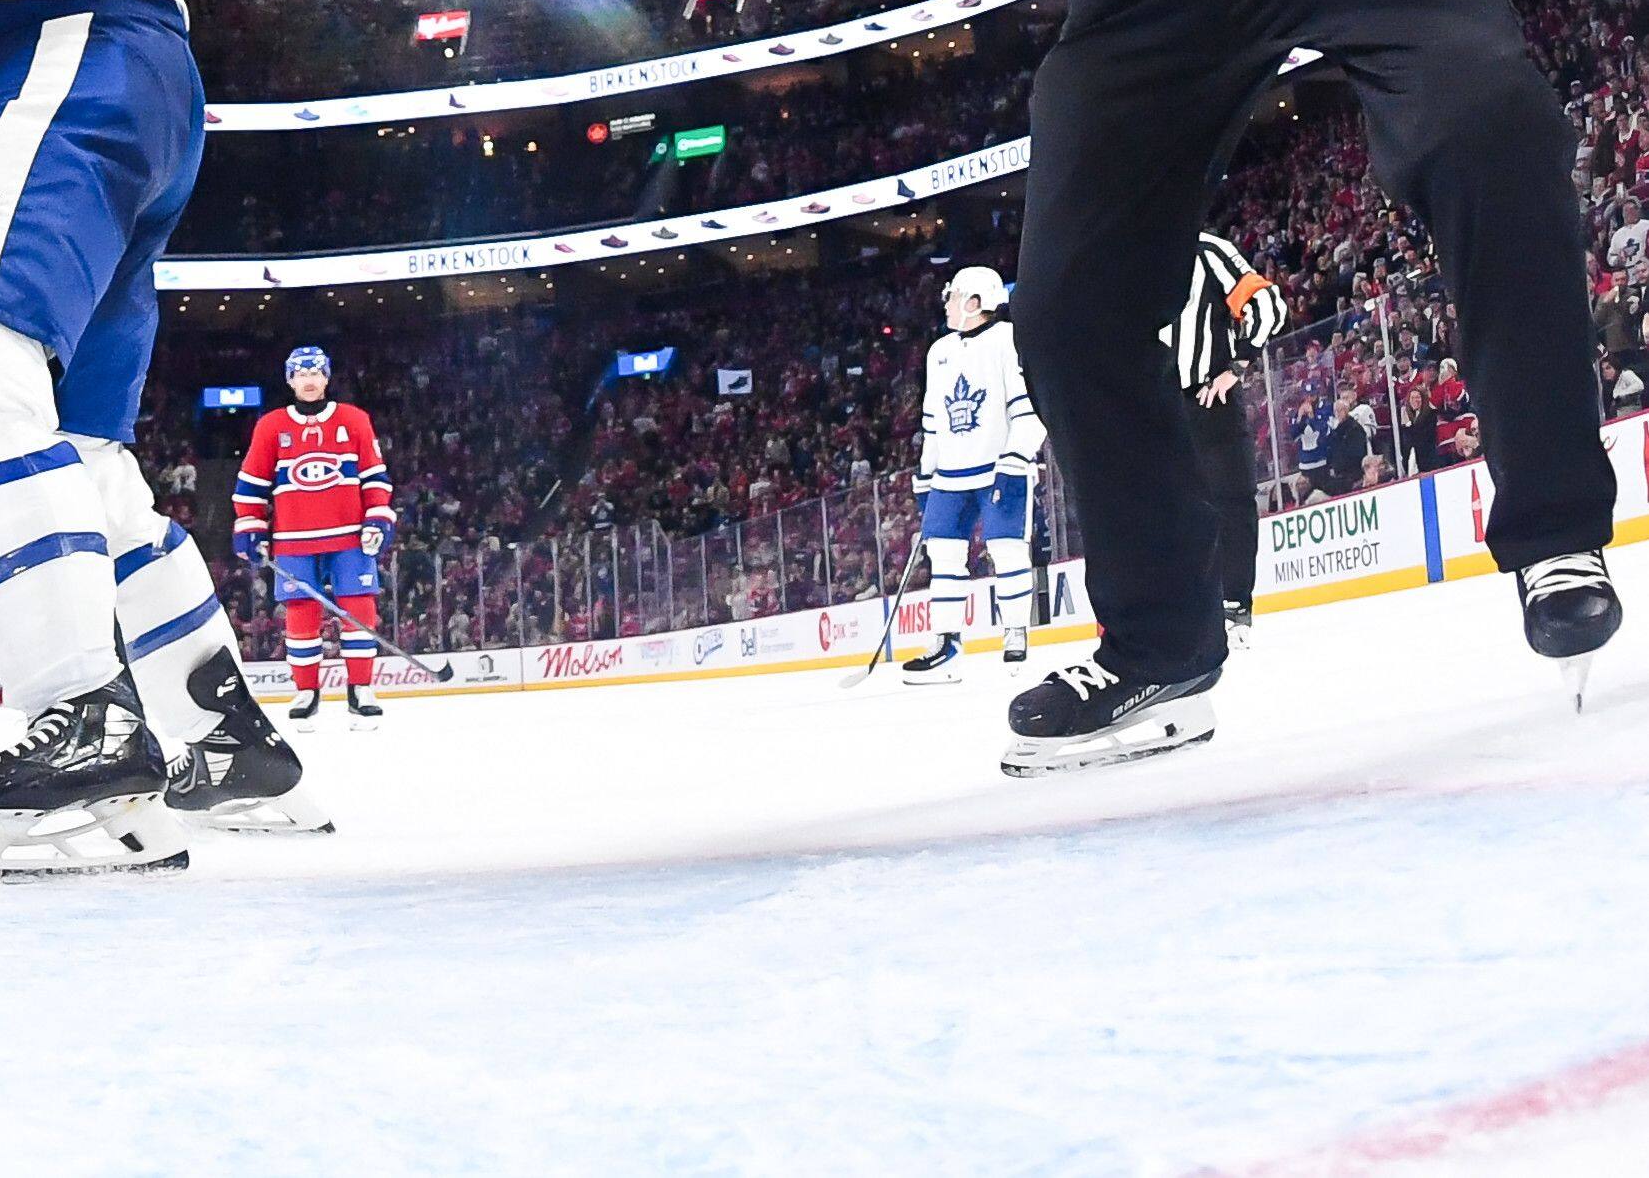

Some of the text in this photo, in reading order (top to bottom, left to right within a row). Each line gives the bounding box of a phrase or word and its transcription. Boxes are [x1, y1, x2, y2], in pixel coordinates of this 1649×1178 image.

[589, 58, 700, 94] BIRKENSTOCK
[408, 245, 532, 274] BIRKENSTOCK
[1271, 495, 1380, 553] DEPOTIUM
[1275, 538, 1381, 585] MINI ENTREPÔT
[537, 645, 623, 679] Molson
